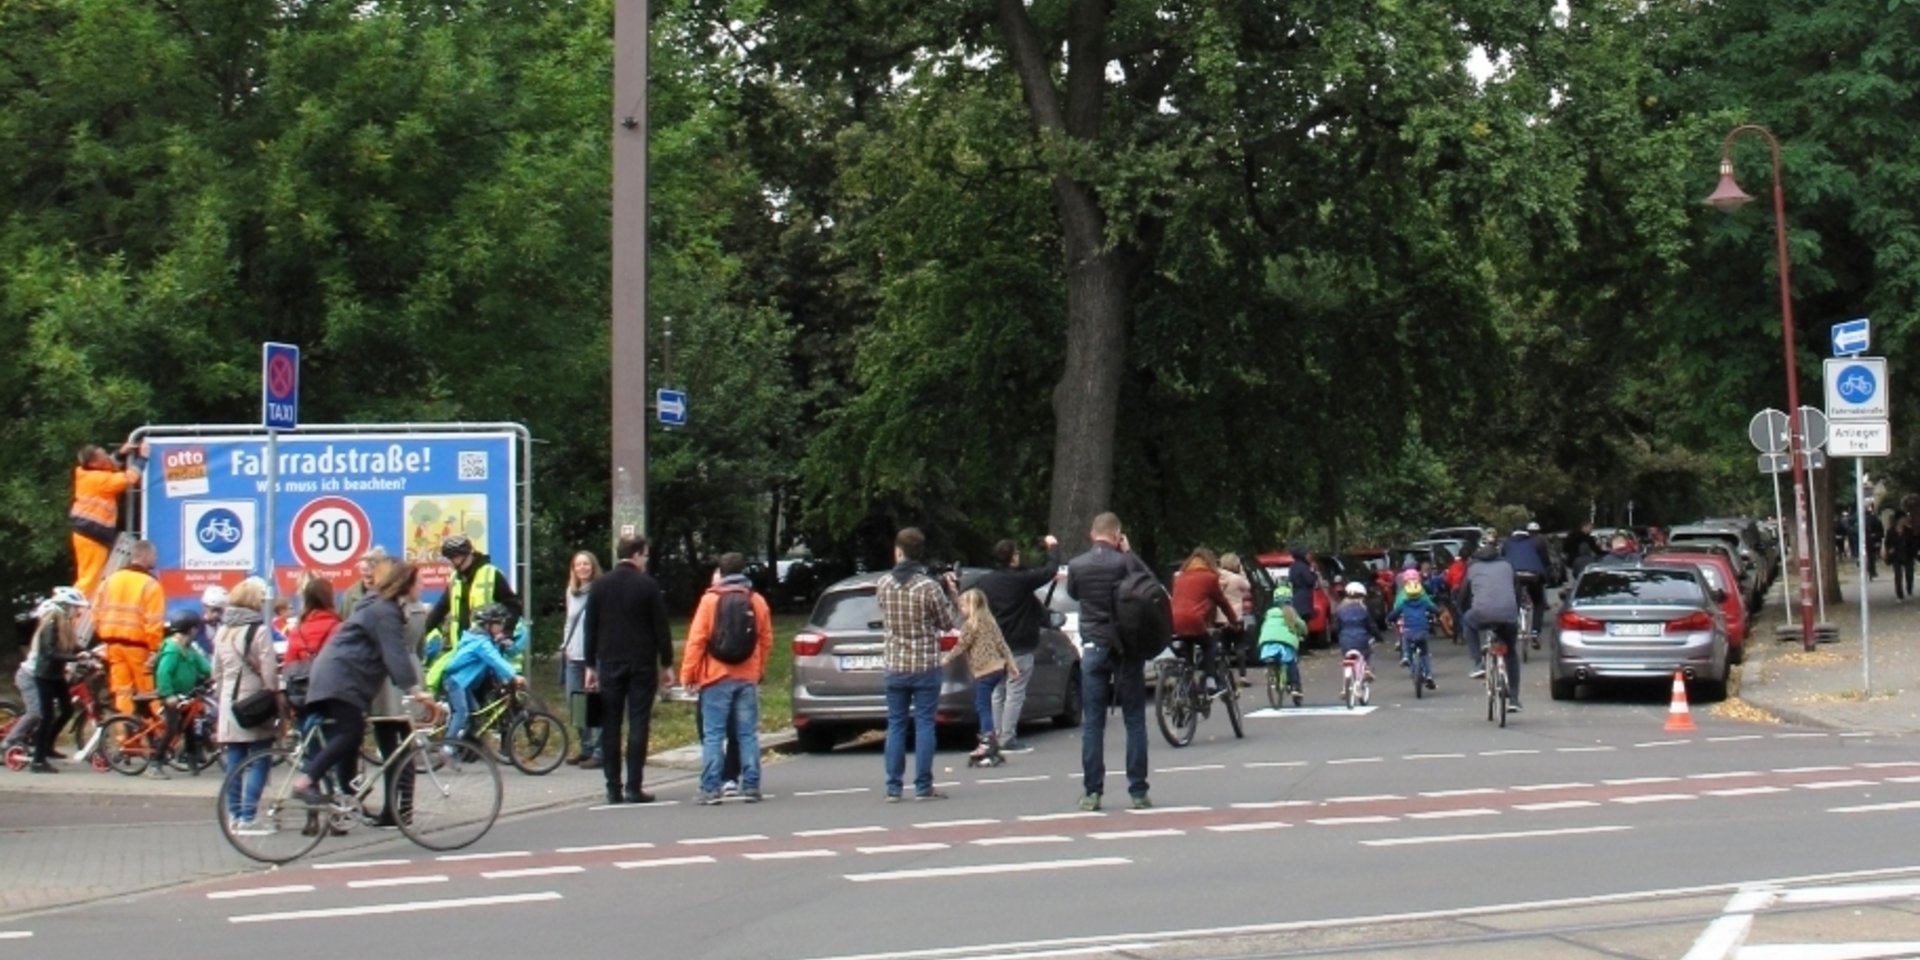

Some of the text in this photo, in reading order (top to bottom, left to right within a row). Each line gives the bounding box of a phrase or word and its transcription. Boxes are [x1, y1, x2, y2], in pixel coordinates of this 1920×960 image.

[268, 402, 295, 422] TAXI
[167, 451, 204, 468] otto
[256, 477, 407, 493] Ws muss ich beachten?
[309, 518, 353, 552] 30
